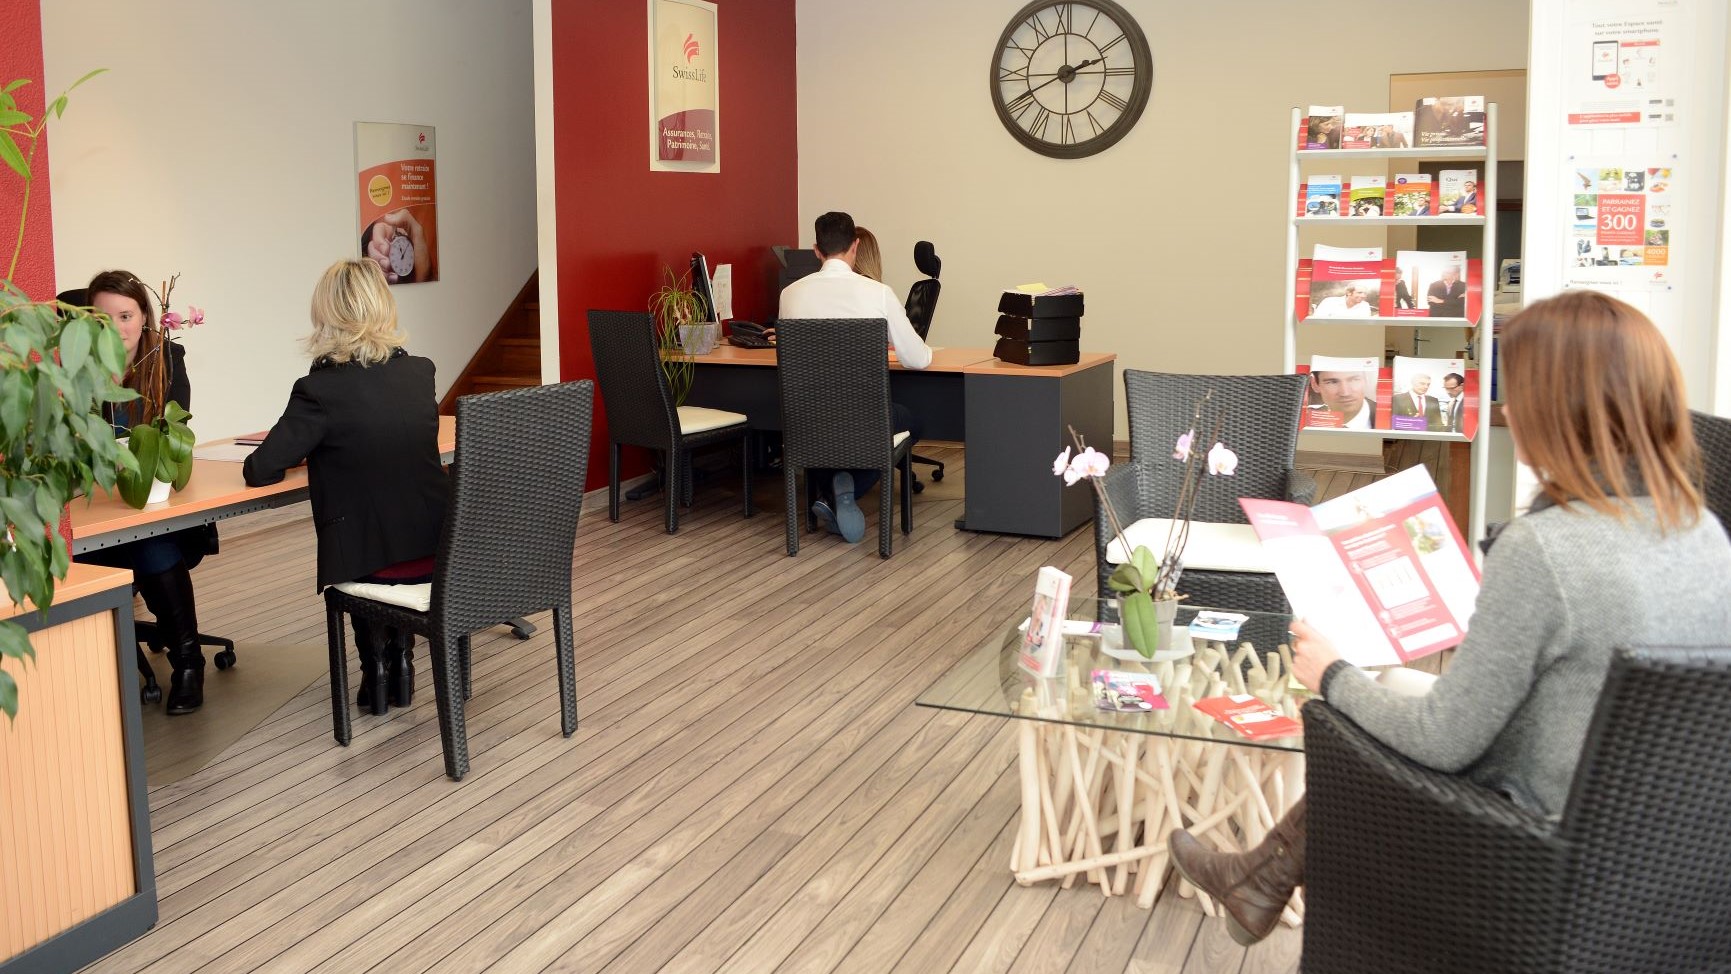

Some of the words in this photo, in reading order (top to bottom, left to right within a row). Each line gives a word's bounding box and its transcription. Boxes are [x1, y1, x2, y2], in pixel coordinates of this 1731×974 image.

[672, 65, 707, 83] SwissLife
[662, 127, 696, 140] Assurances,
[667, 138, 698, 152] Patrimoine,
[400, 163, 414, 173] Votre
[1601, 214, 1637, 230] 300
